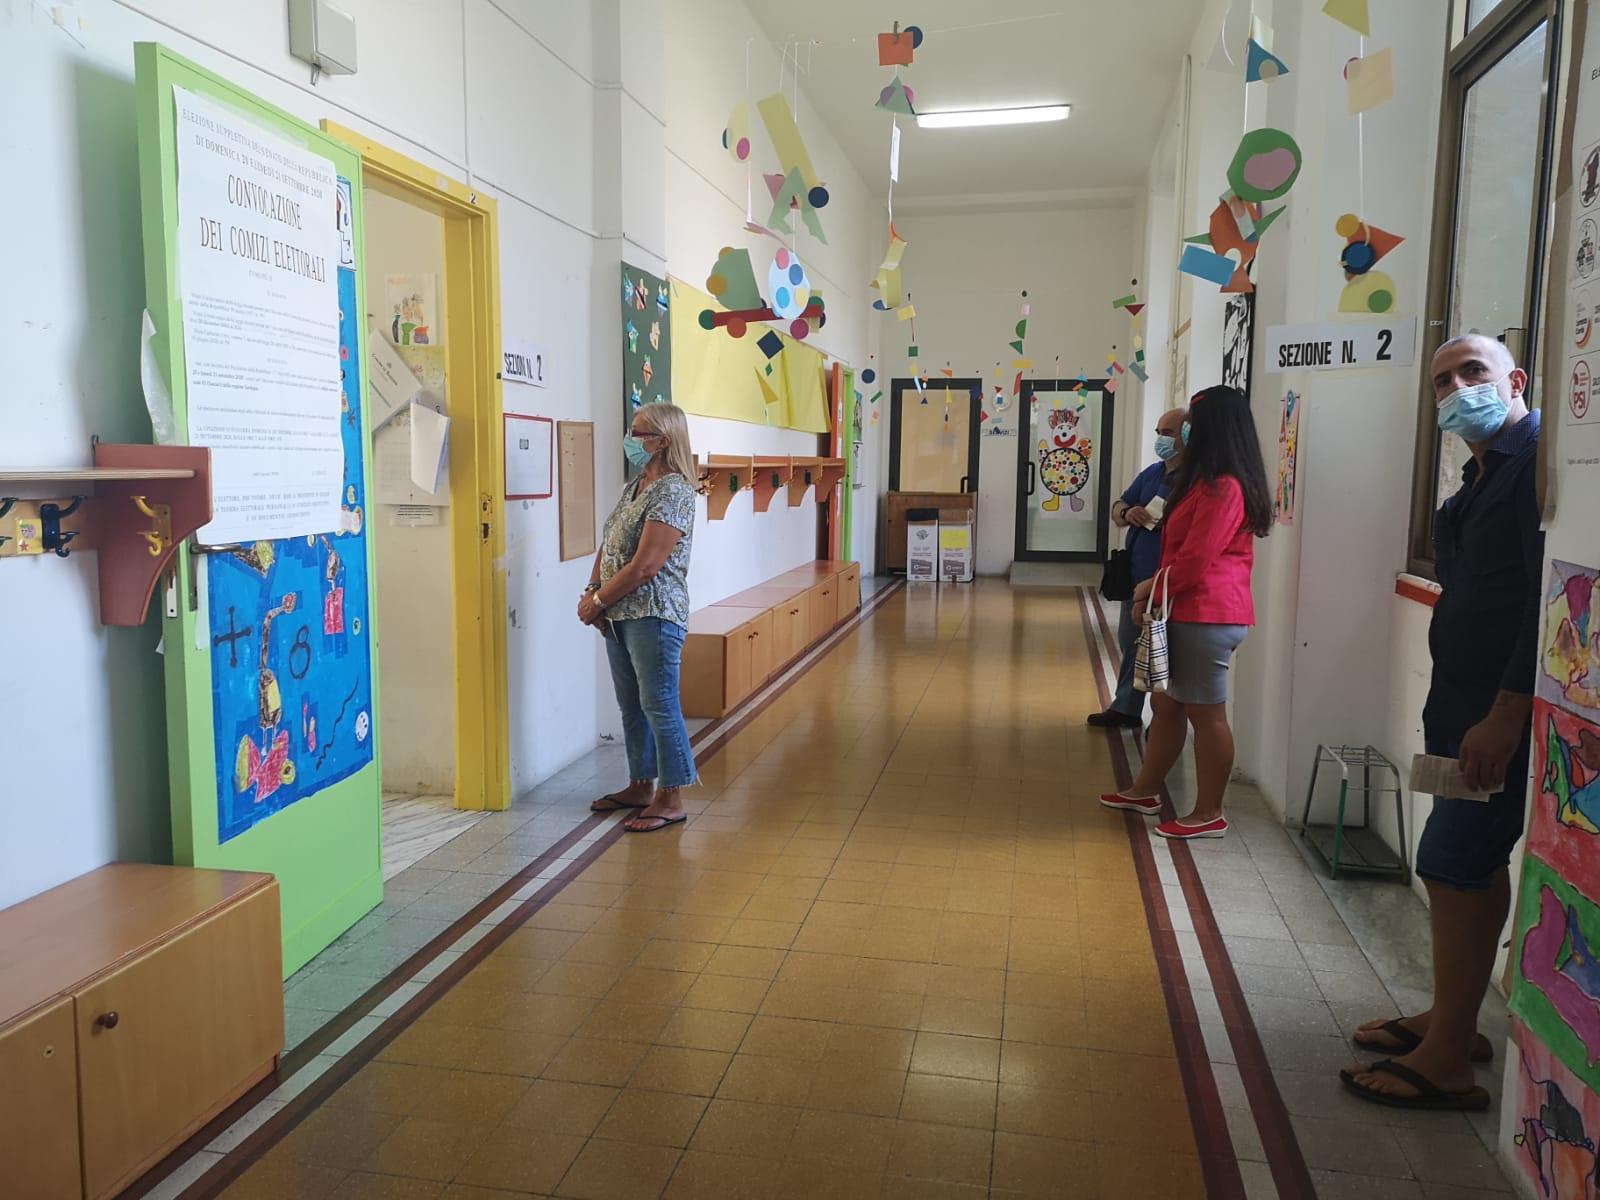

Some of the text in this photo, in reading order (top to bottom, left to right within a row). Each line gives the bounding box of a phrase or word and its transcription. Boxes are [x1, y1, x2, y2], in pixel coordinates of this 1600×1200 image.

[183, 108, 214, 132] ELEZIONE
[195, 134, 204, 148] DI
[205, 138, 241, 162] DOMENICA
[228, 174, 302, 230] CONVOCAZIONE
[200, 217, 326, 283] DEI COMIZI ELETTORALI
[1278, 329, 1393, 368] SEZIONE N. 2
[536, 354, 543, 381] 2
[1573, 391, 1586, 410] PSI
